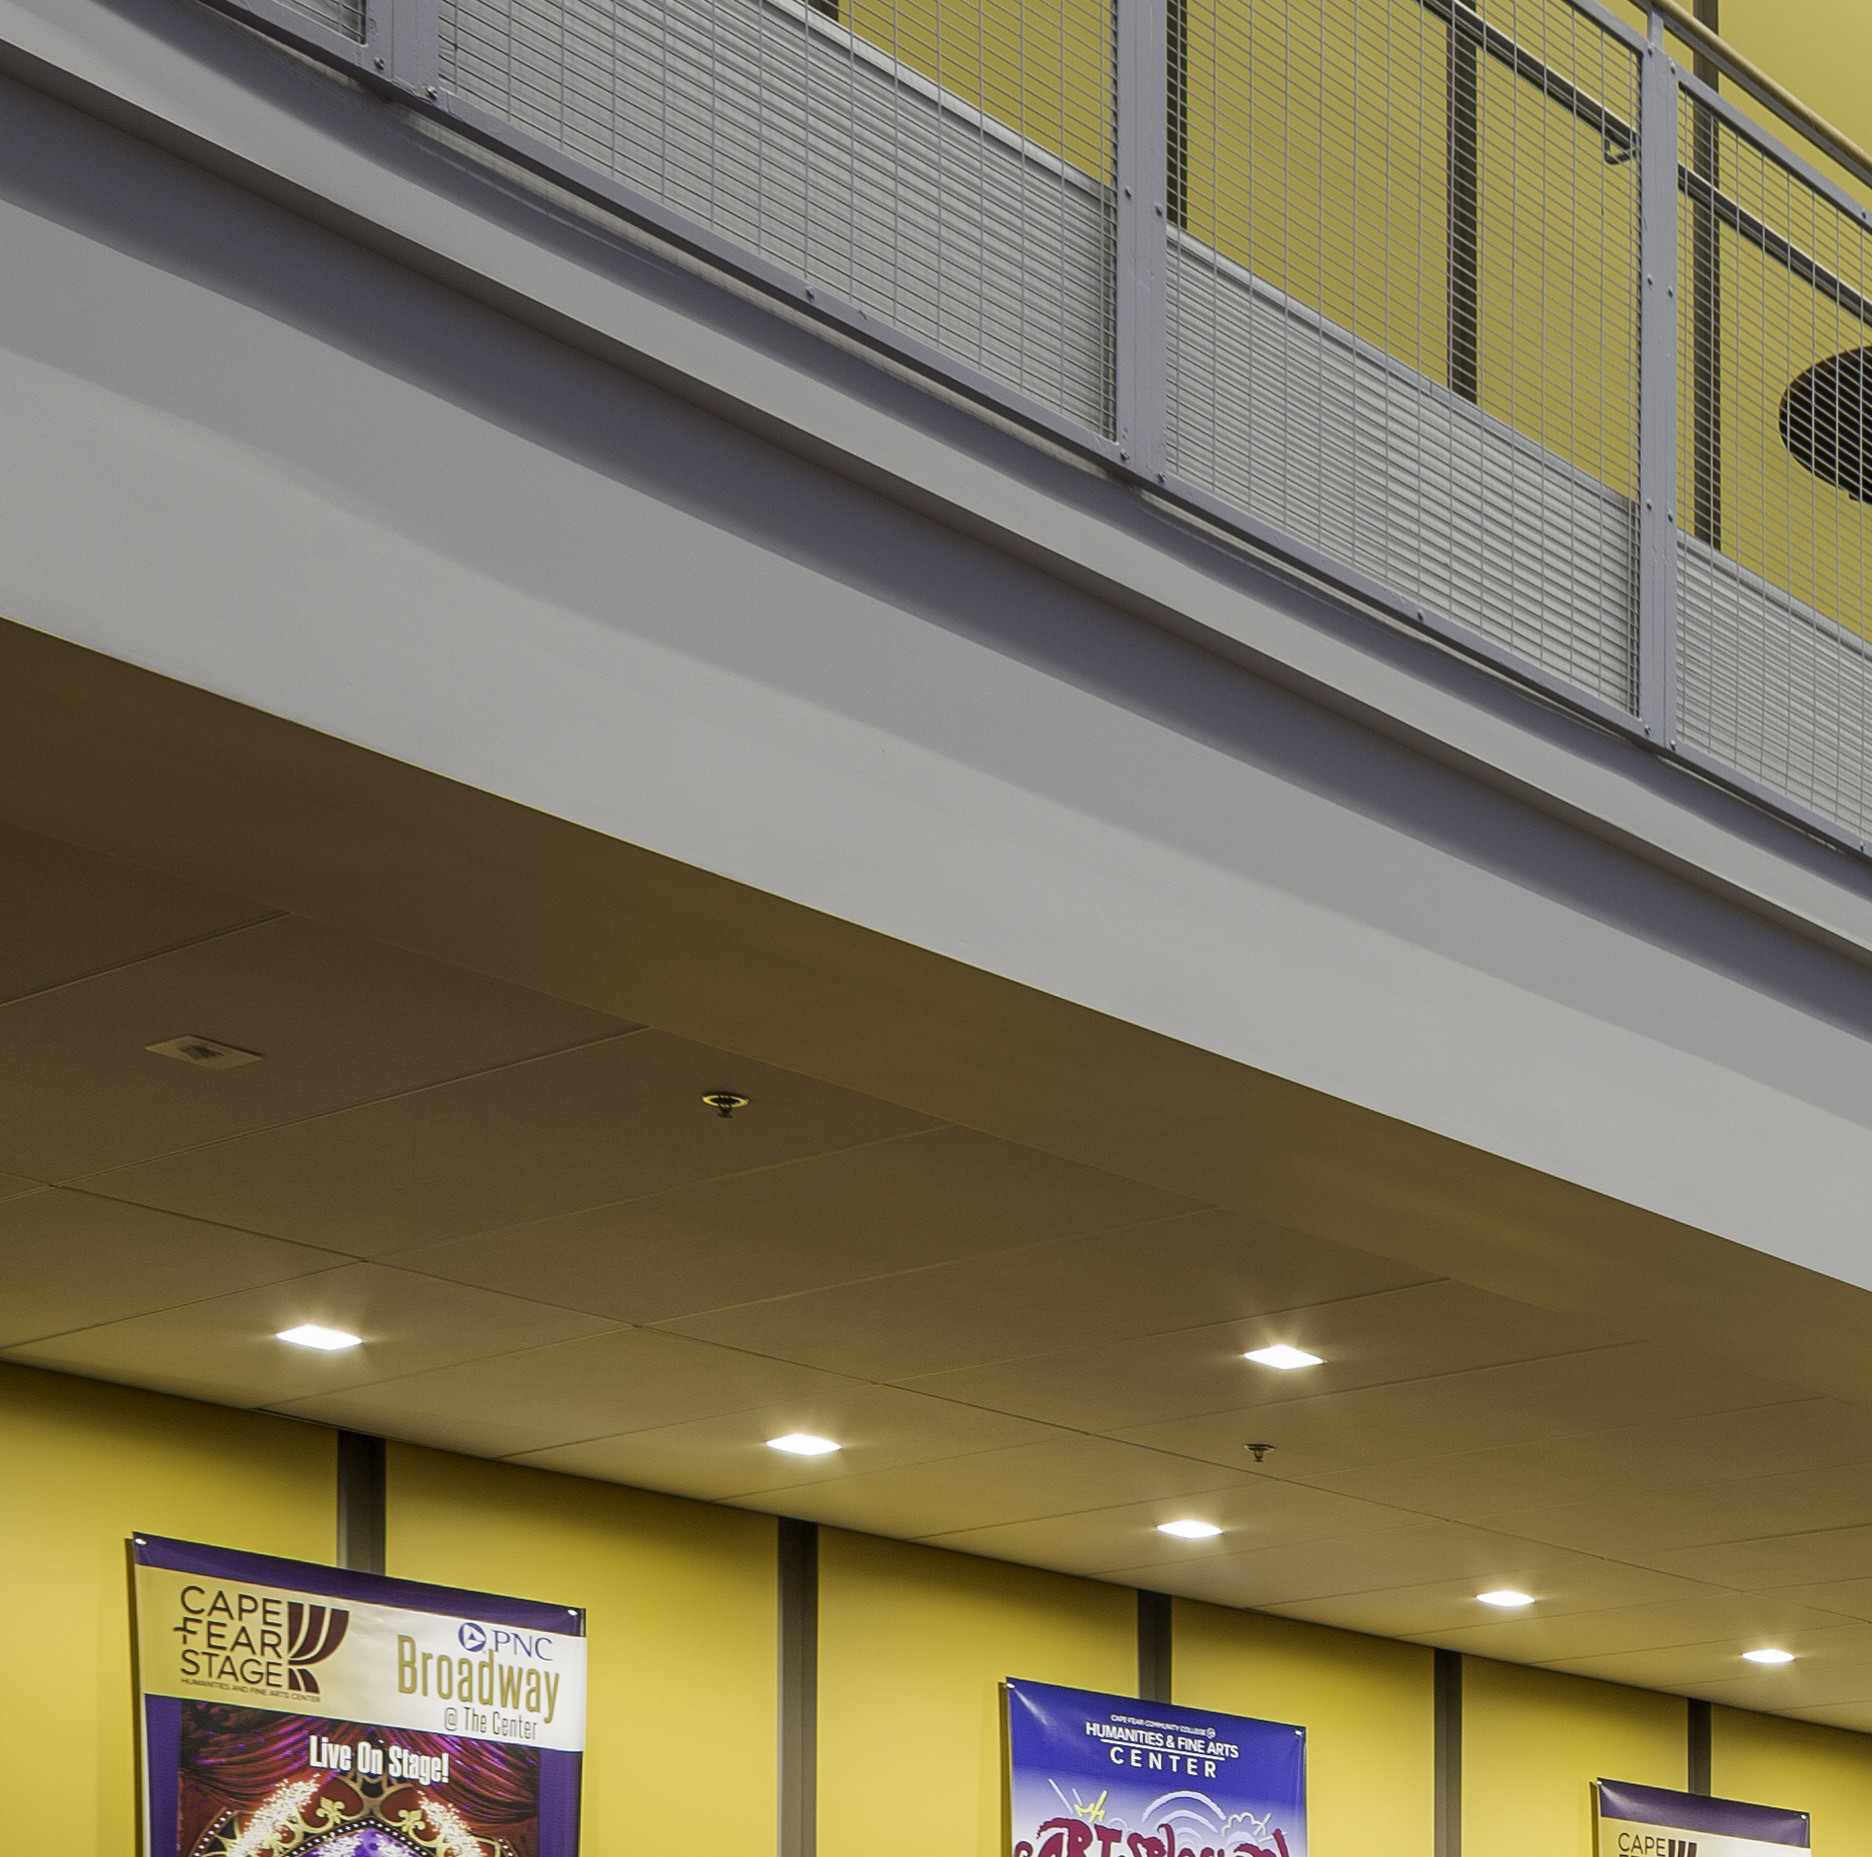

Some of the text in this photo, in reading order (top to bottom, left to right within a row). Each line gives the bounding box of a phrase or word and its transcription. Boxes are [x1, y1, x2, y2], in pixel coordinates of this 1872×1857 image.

[181, 1586, 282, 1627] CAPE
[173, 1617, 282, 1659] FEAR
[492, 1630, 552, 1661] PNC
[181, 1649, 282, 1688] STAGE
[398, 1634, 560, 1724] Broadway
[445, 1707, 538, 1740] @ The Center
[1086, 1721, 1239, 1758] HUMANITIES & FINE ARTS
[309, 1735, 449, 1785] Live On Stage!
[1109, 1746, 1217, 1778] CENTER
[1618, 1832, 1666, 1857] CAPE
